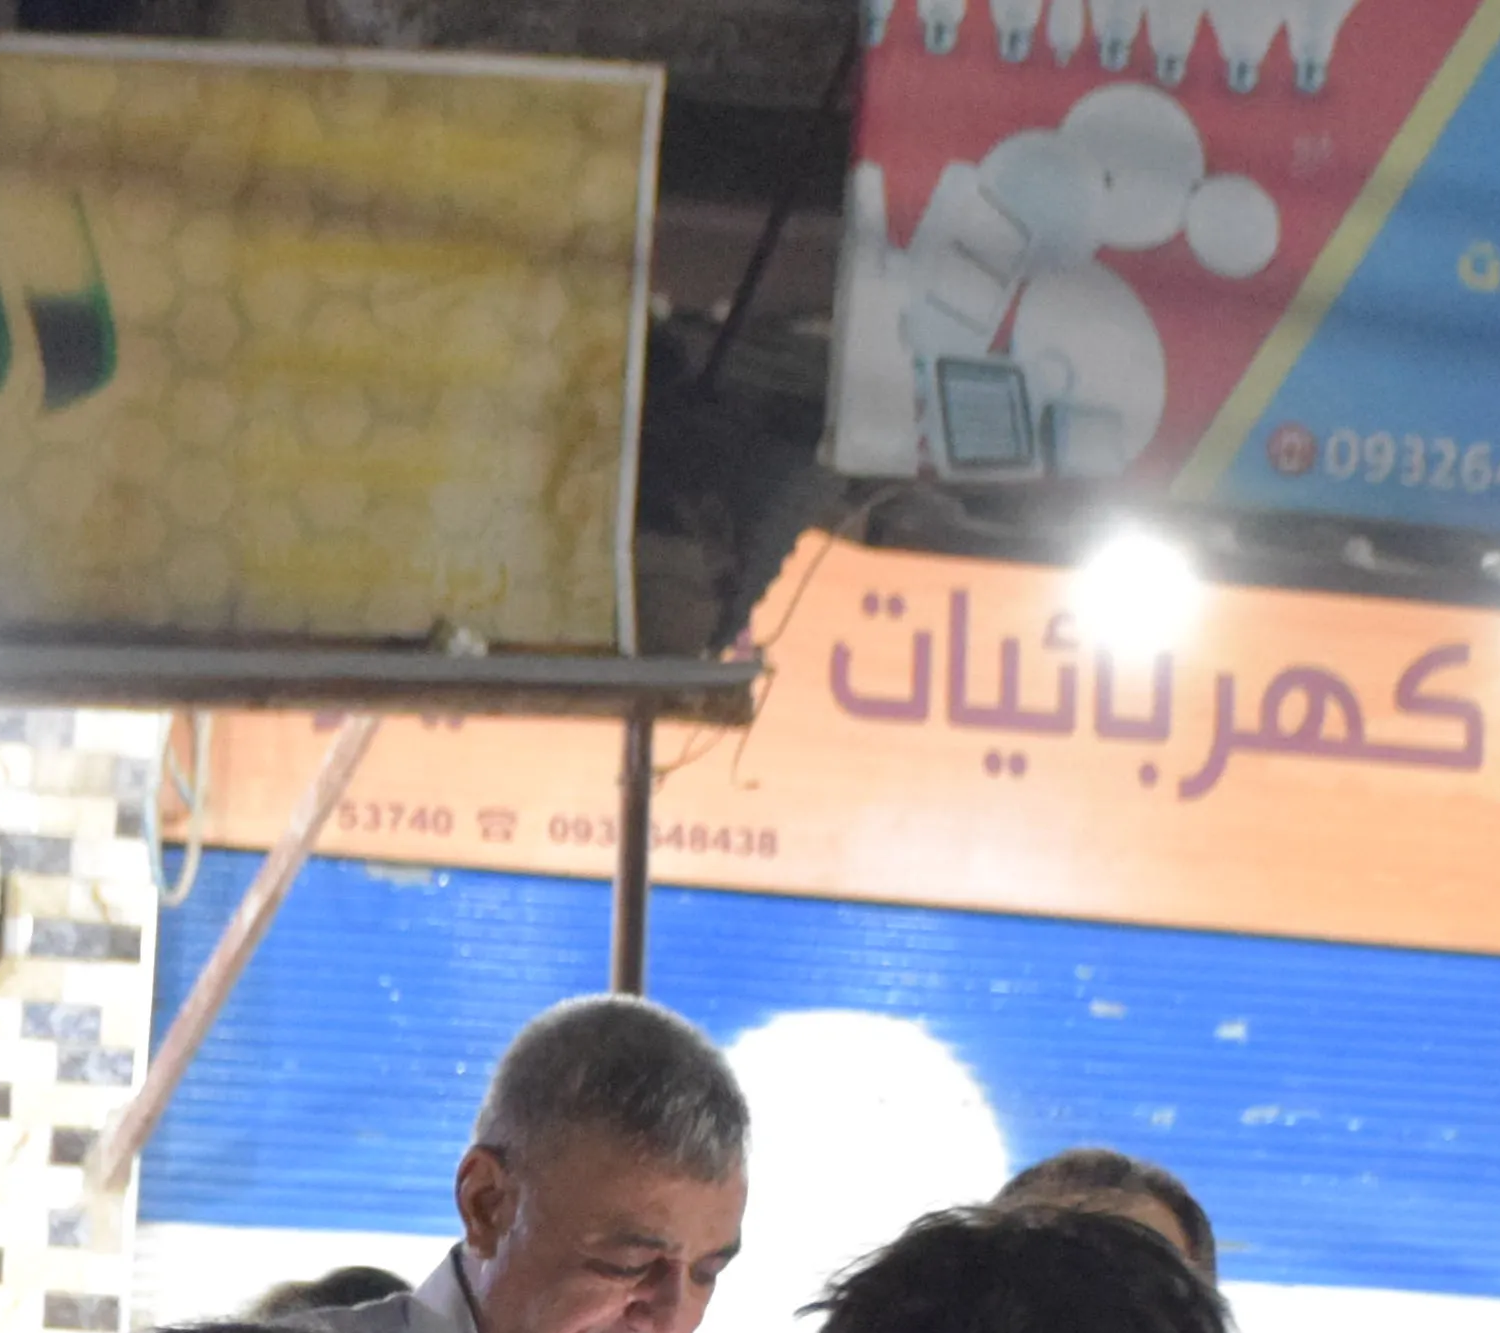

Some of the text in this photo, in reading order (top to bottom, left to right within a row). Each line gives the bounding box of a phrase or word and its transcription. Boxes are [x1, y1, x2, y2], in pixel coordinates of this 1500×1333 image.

[829, 588, 1485, 800] كهربائيات
[336, 801, 780, 859] 53740 093648438
